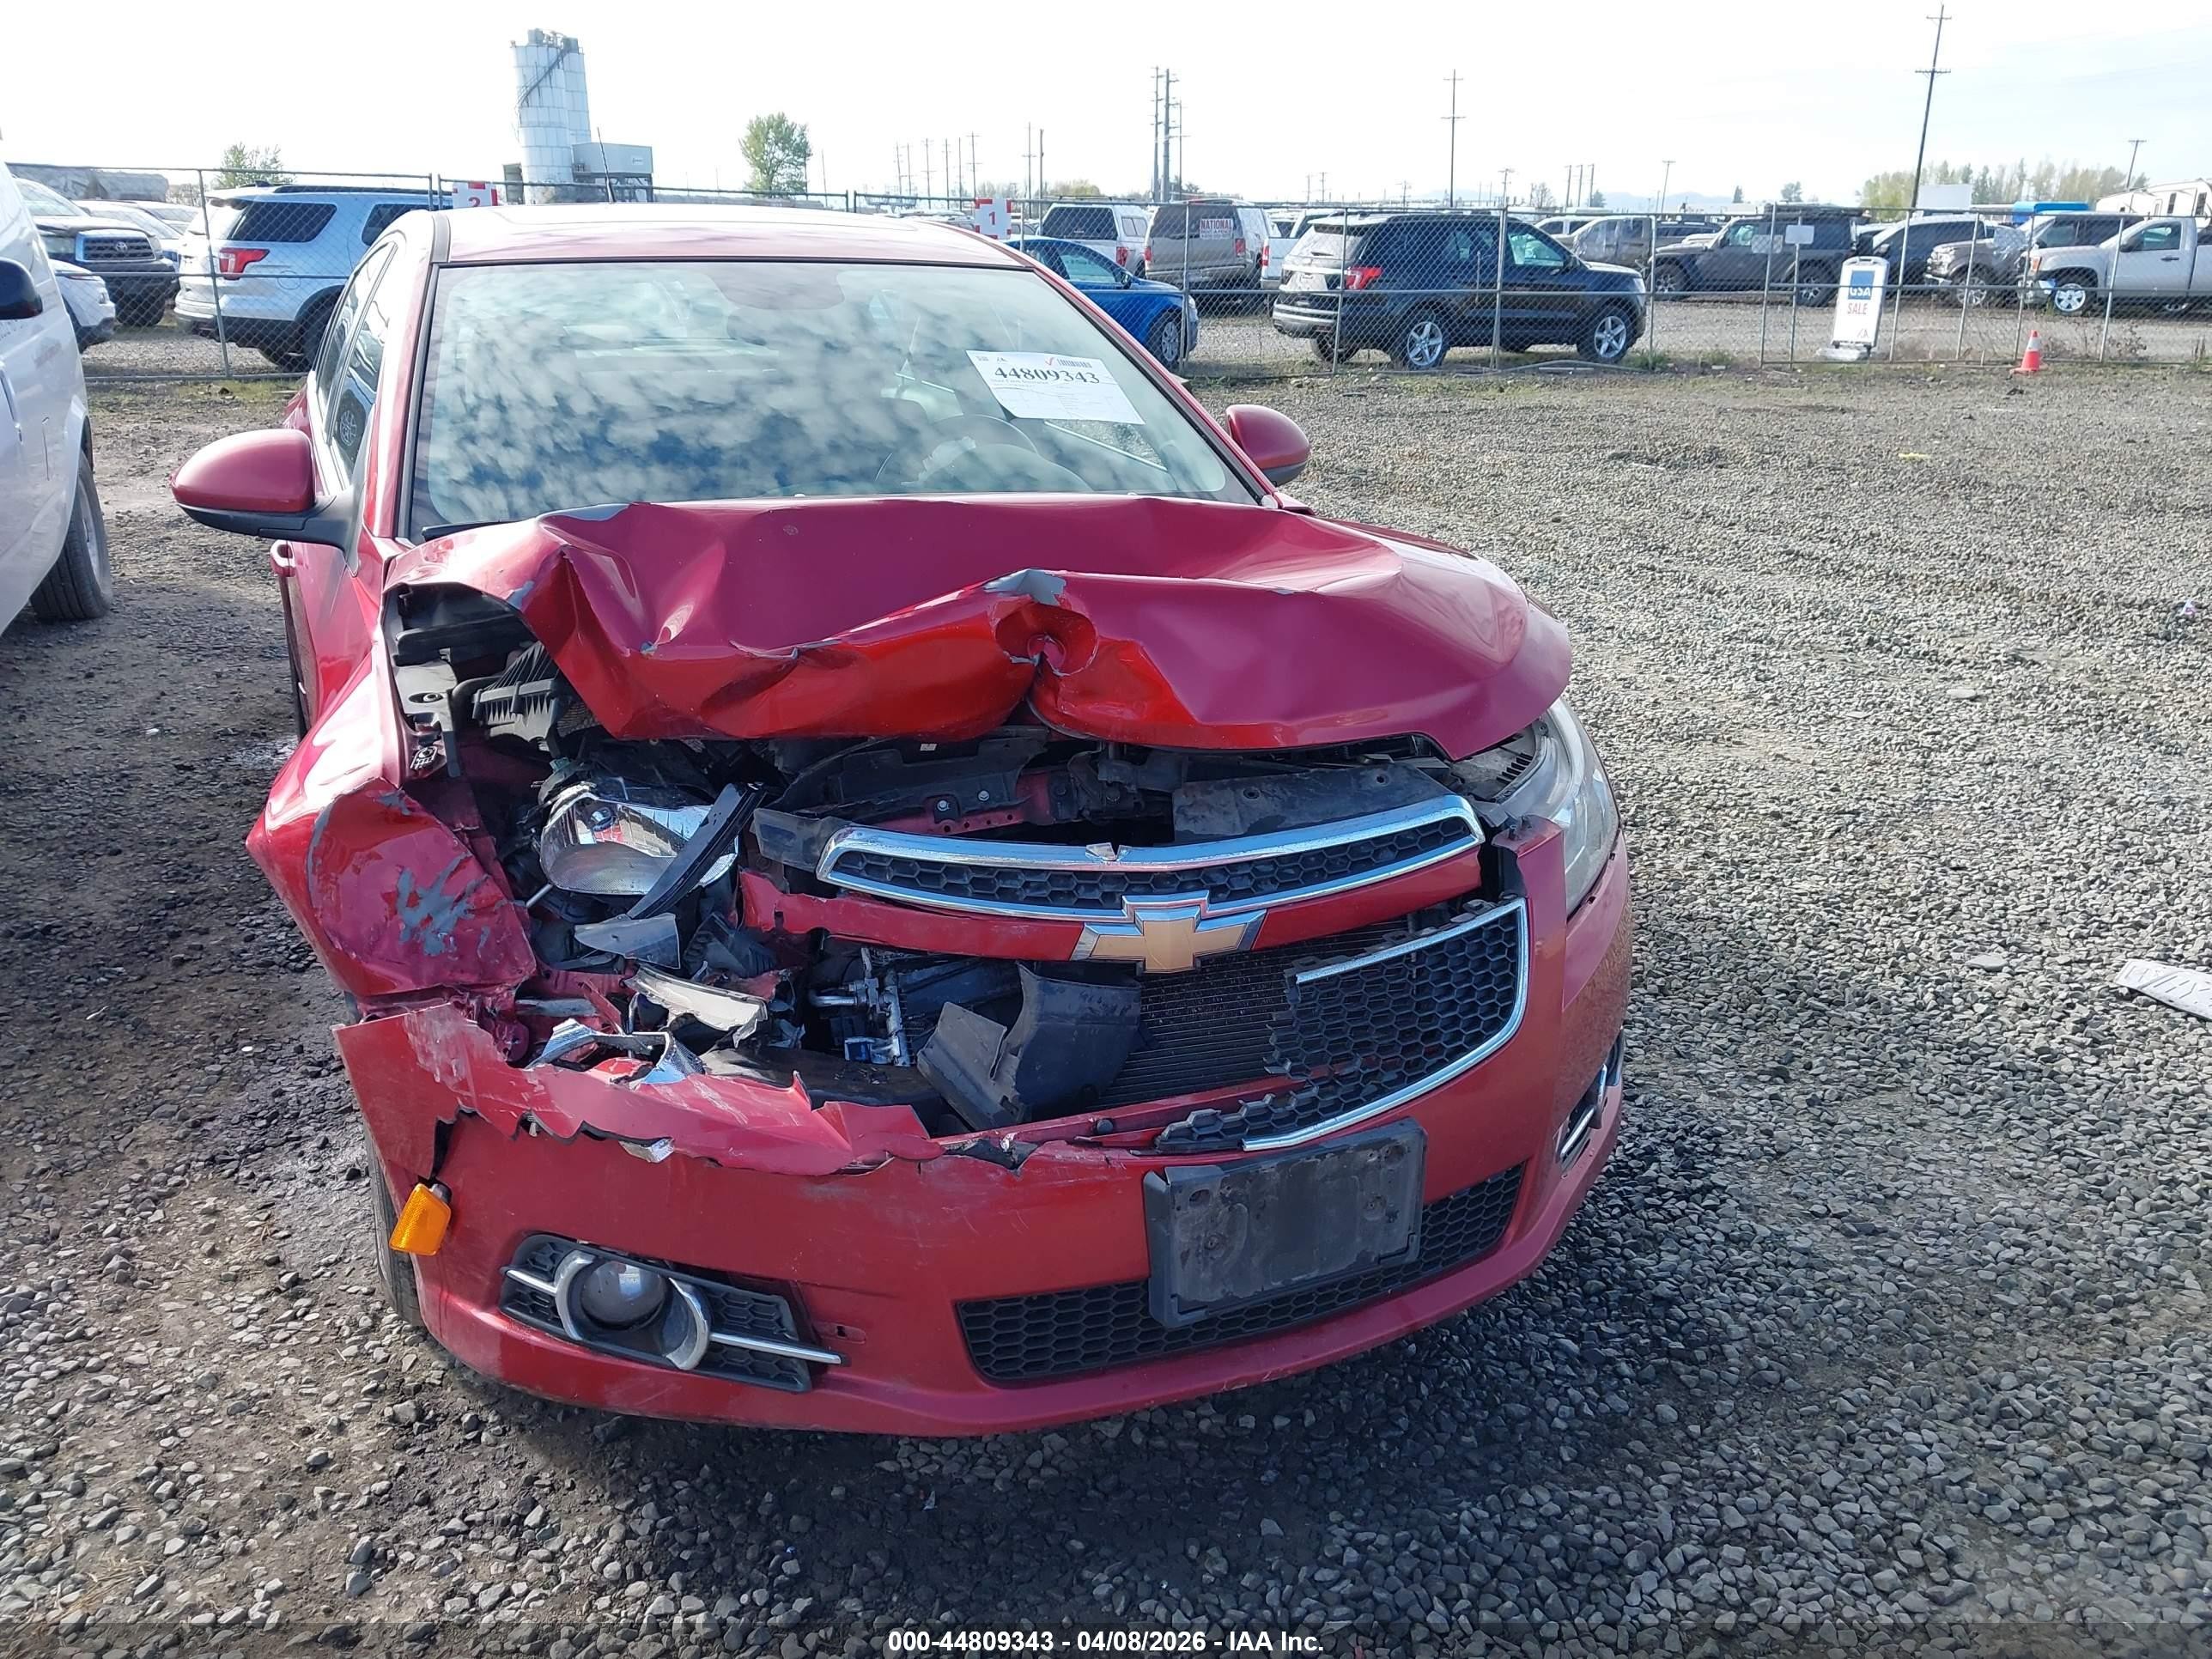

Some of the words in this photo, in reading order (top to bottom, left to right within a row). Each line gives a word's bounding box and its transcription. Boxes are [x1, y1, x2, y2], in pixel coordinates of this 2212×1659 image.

[988, 211, 996, 226] 1
[1200, 219, 1232, 229] NATIONAL
[1849, 285, 1871, 297] GSA
[1847, 302, 1869, 315] SALE
[994, 367, 1100, 384] 44809343
